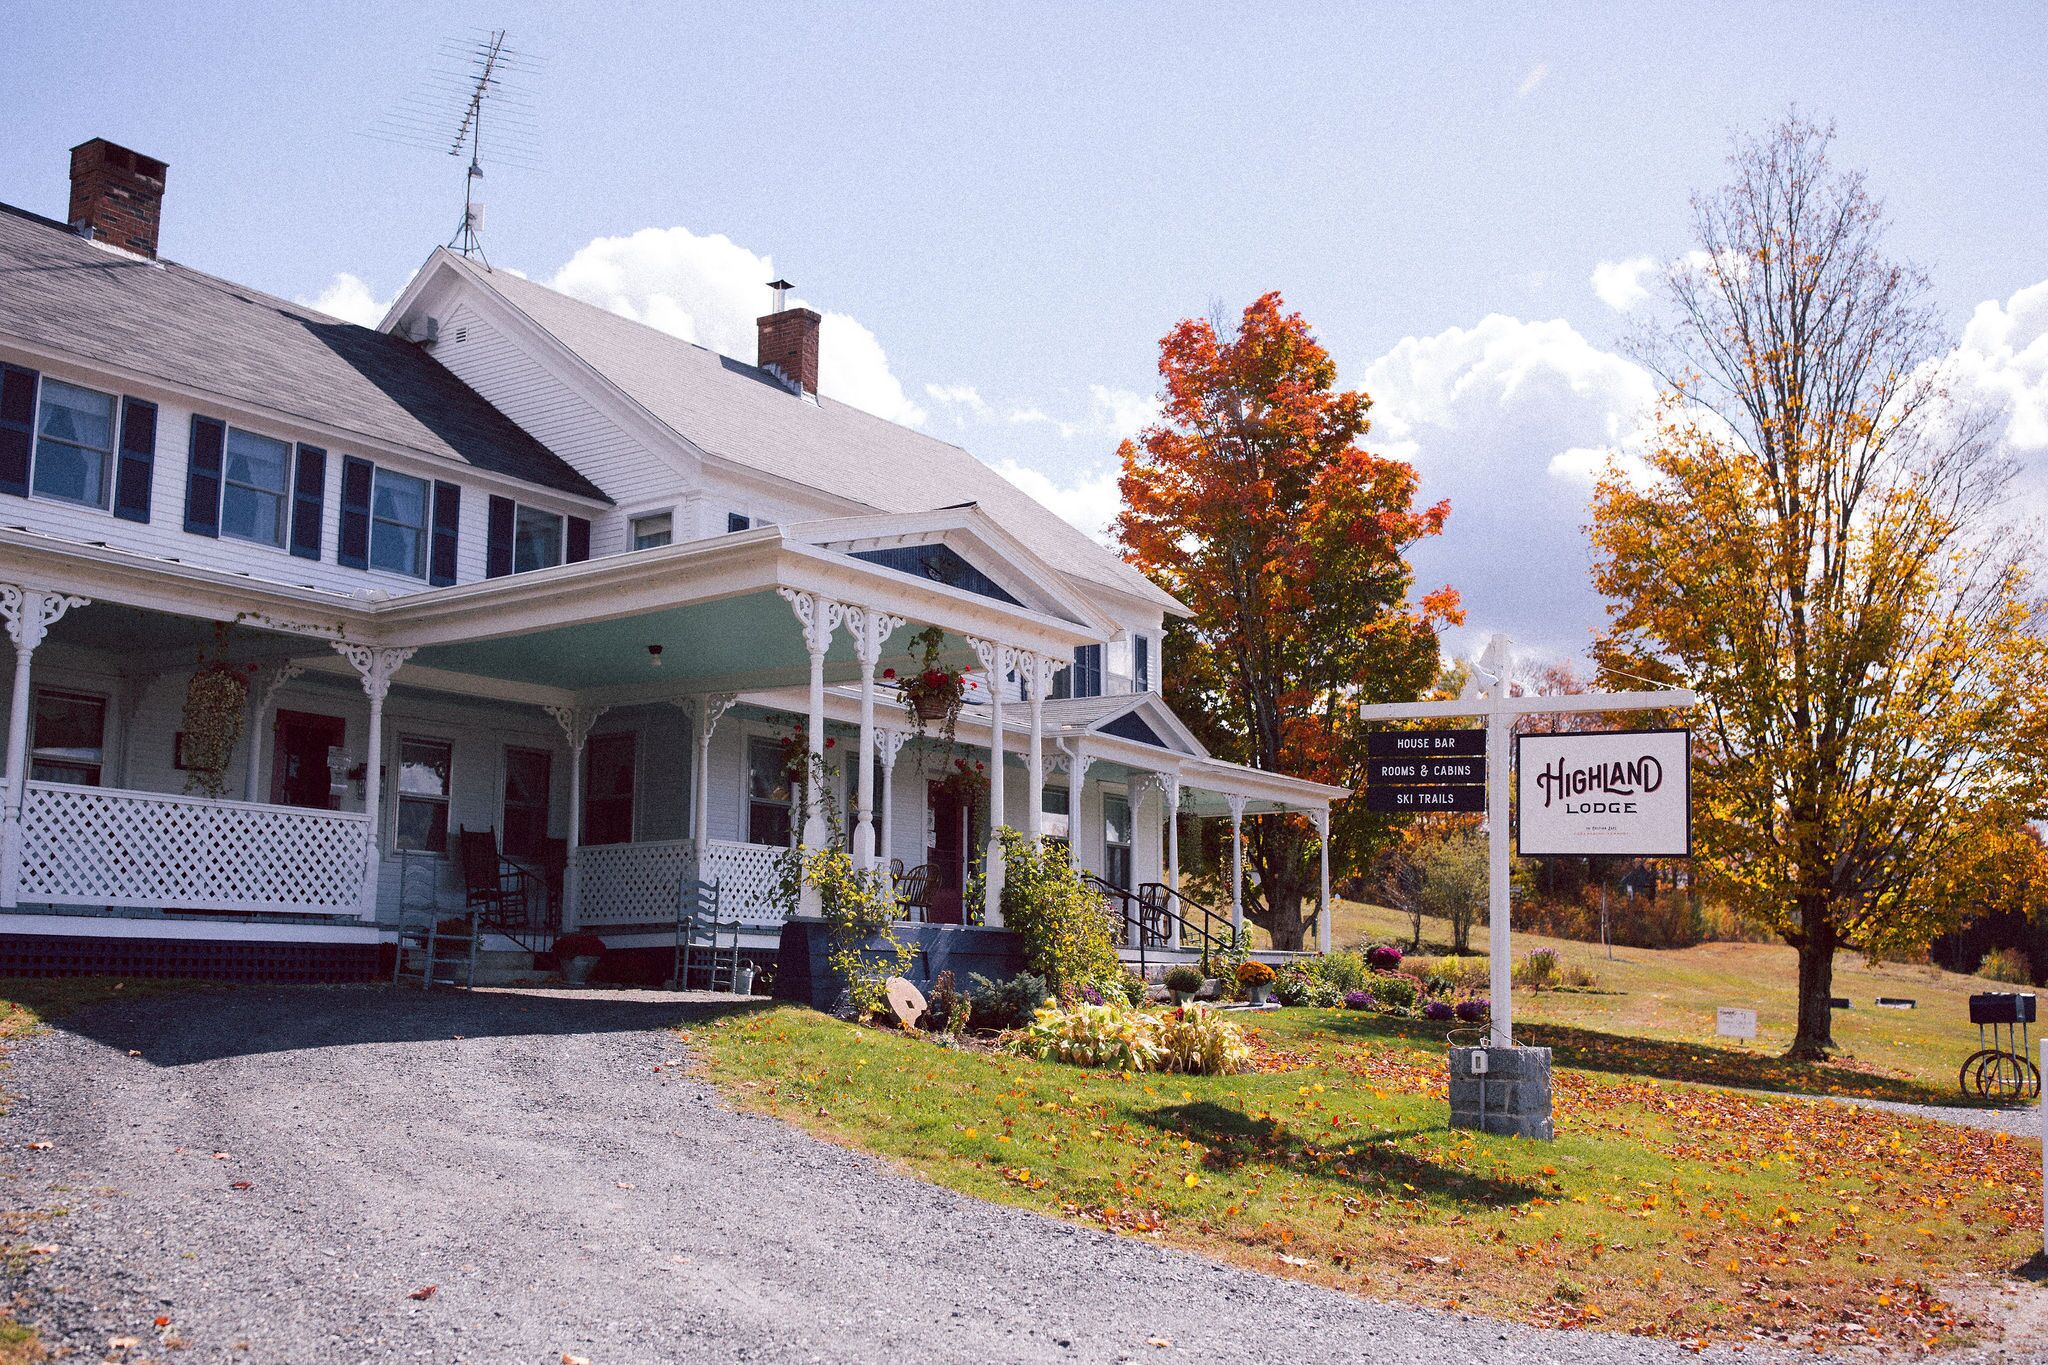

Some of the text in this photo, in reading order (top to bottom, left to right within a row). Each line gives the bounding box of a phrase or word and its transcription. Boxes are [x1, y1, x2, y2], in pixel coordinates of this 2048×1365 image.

[1397, 737, 1456, 749] HOUSE BAR
[1381, 764, 1471, 777] ROOMS & CABINS
[1536, 755, 1663, 808] HIGHLAND
[1396, 793, 1454, 804] SKI TRAILS
[1566, 802, 1637, 814] LODGE
